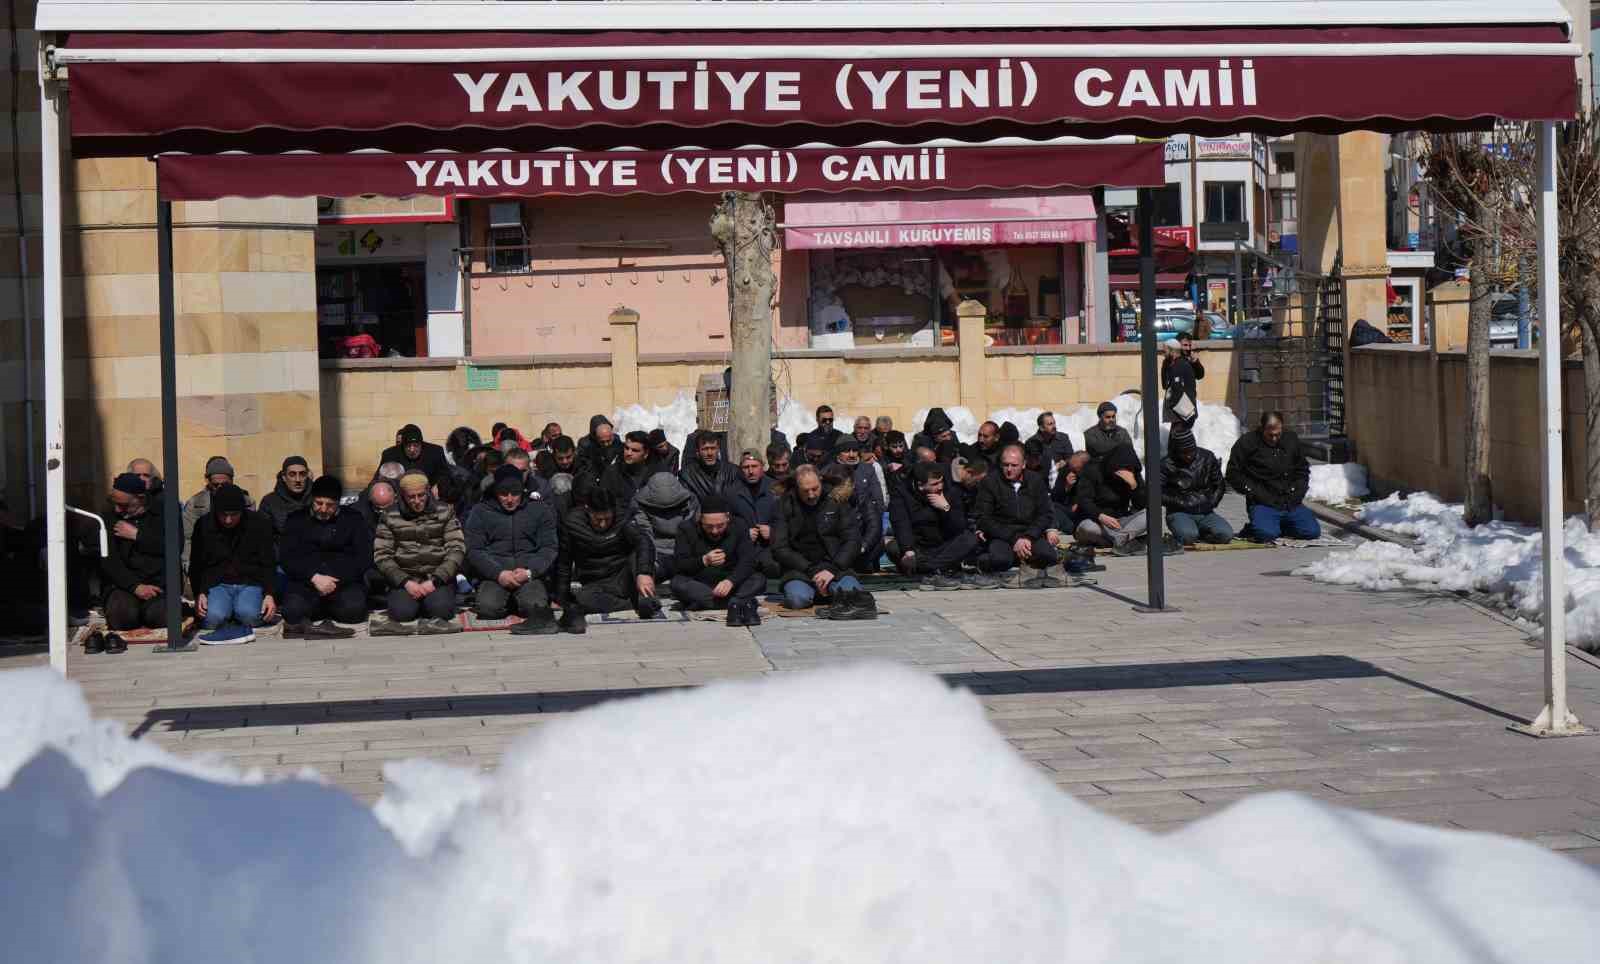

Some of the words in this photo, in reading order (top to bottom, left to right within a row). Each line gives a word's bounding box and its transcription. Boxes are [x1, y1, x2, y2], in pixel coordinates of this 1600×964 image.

[453, 60, 801, 112] YAKUTİYE
[835, 59, 1038, 110] (YENİ)
[1074, 59, 1257, 107] CAMİİ
[406, 153, 638, 187] YAKUTİYE
[660, 151, 798, 184] (YENİ)
[822, 148, 946, 182] CAMİİ
[814, 229, 889, 246] TAVŞANLI
[899, 226, 992, 244] KURUYEMİŞ
